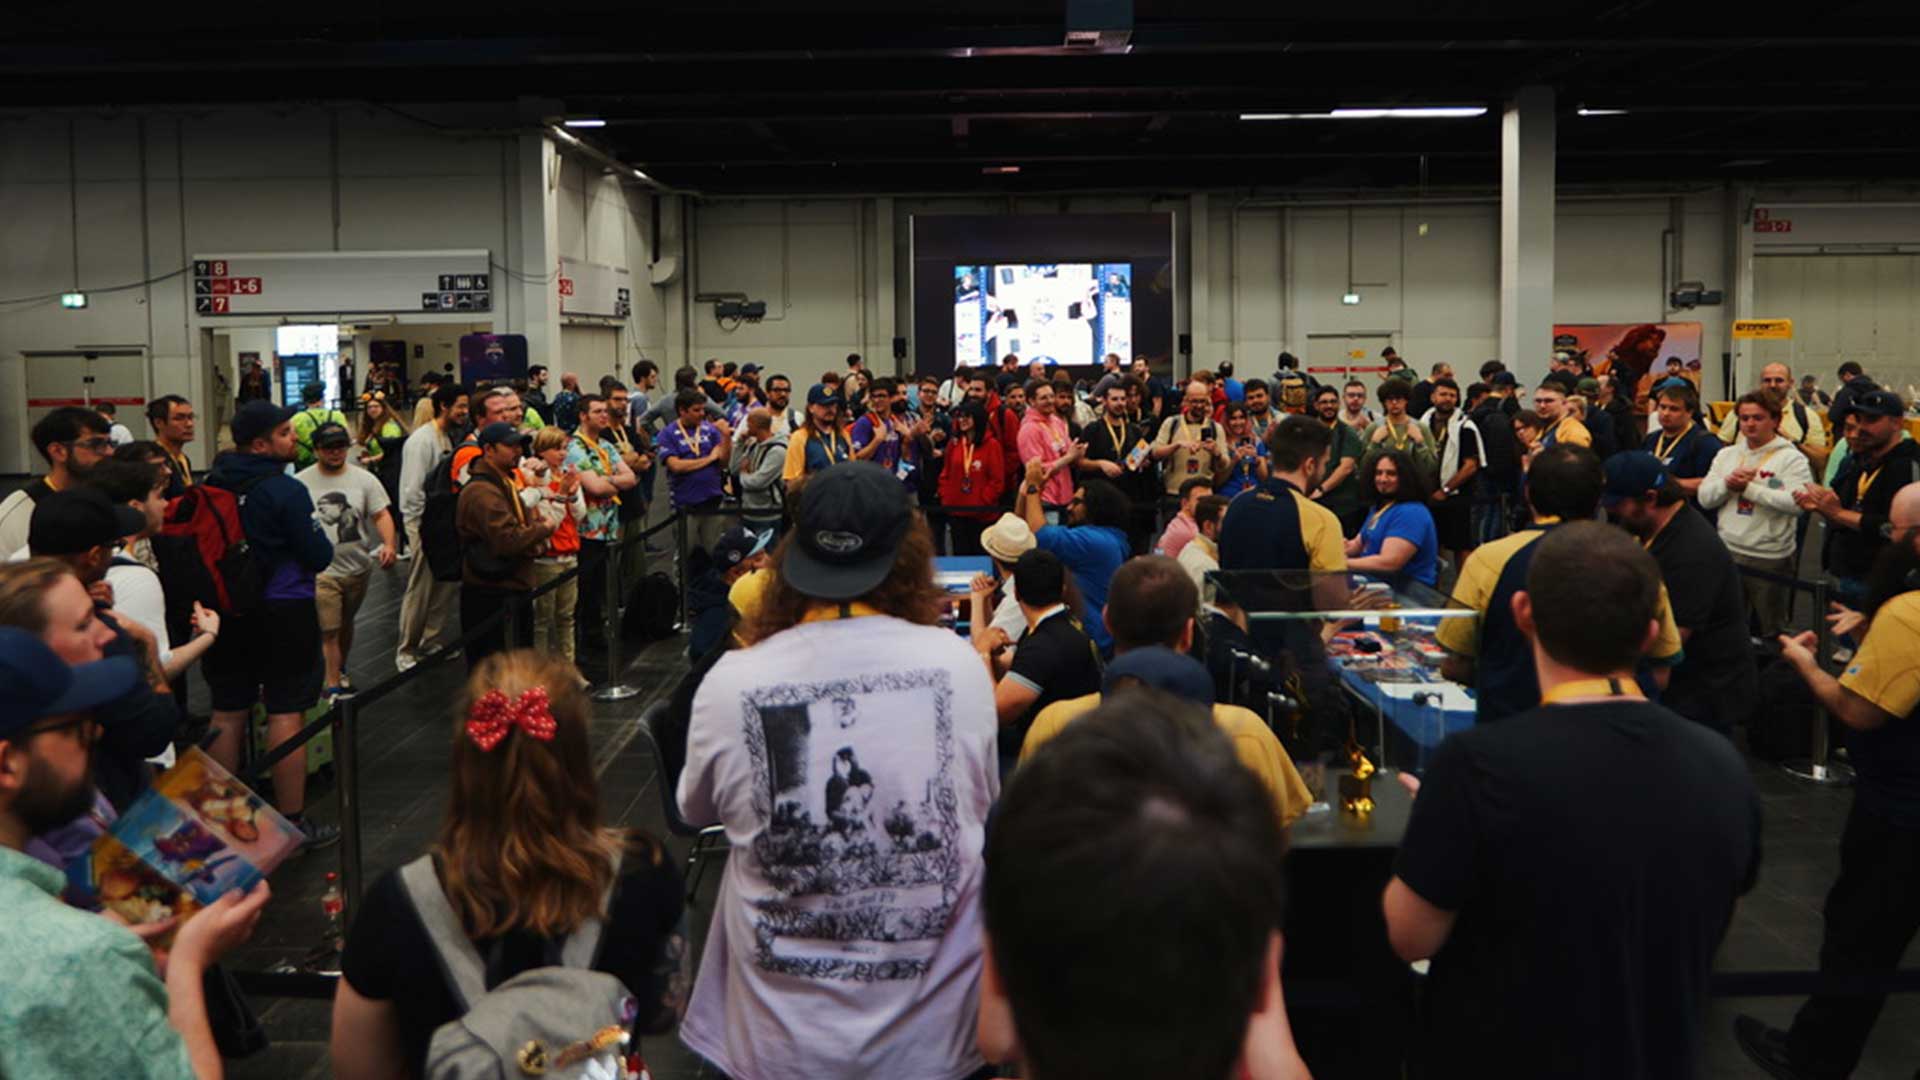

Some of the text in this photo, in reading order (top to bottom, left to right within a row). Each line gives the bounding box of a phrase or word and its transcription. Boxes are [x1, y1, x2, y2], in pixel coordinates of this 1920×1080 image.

[214, 262, 225, 275] 8
[233, 280, 258, 293] 1-6
[215, 297, 226, 311] 7
